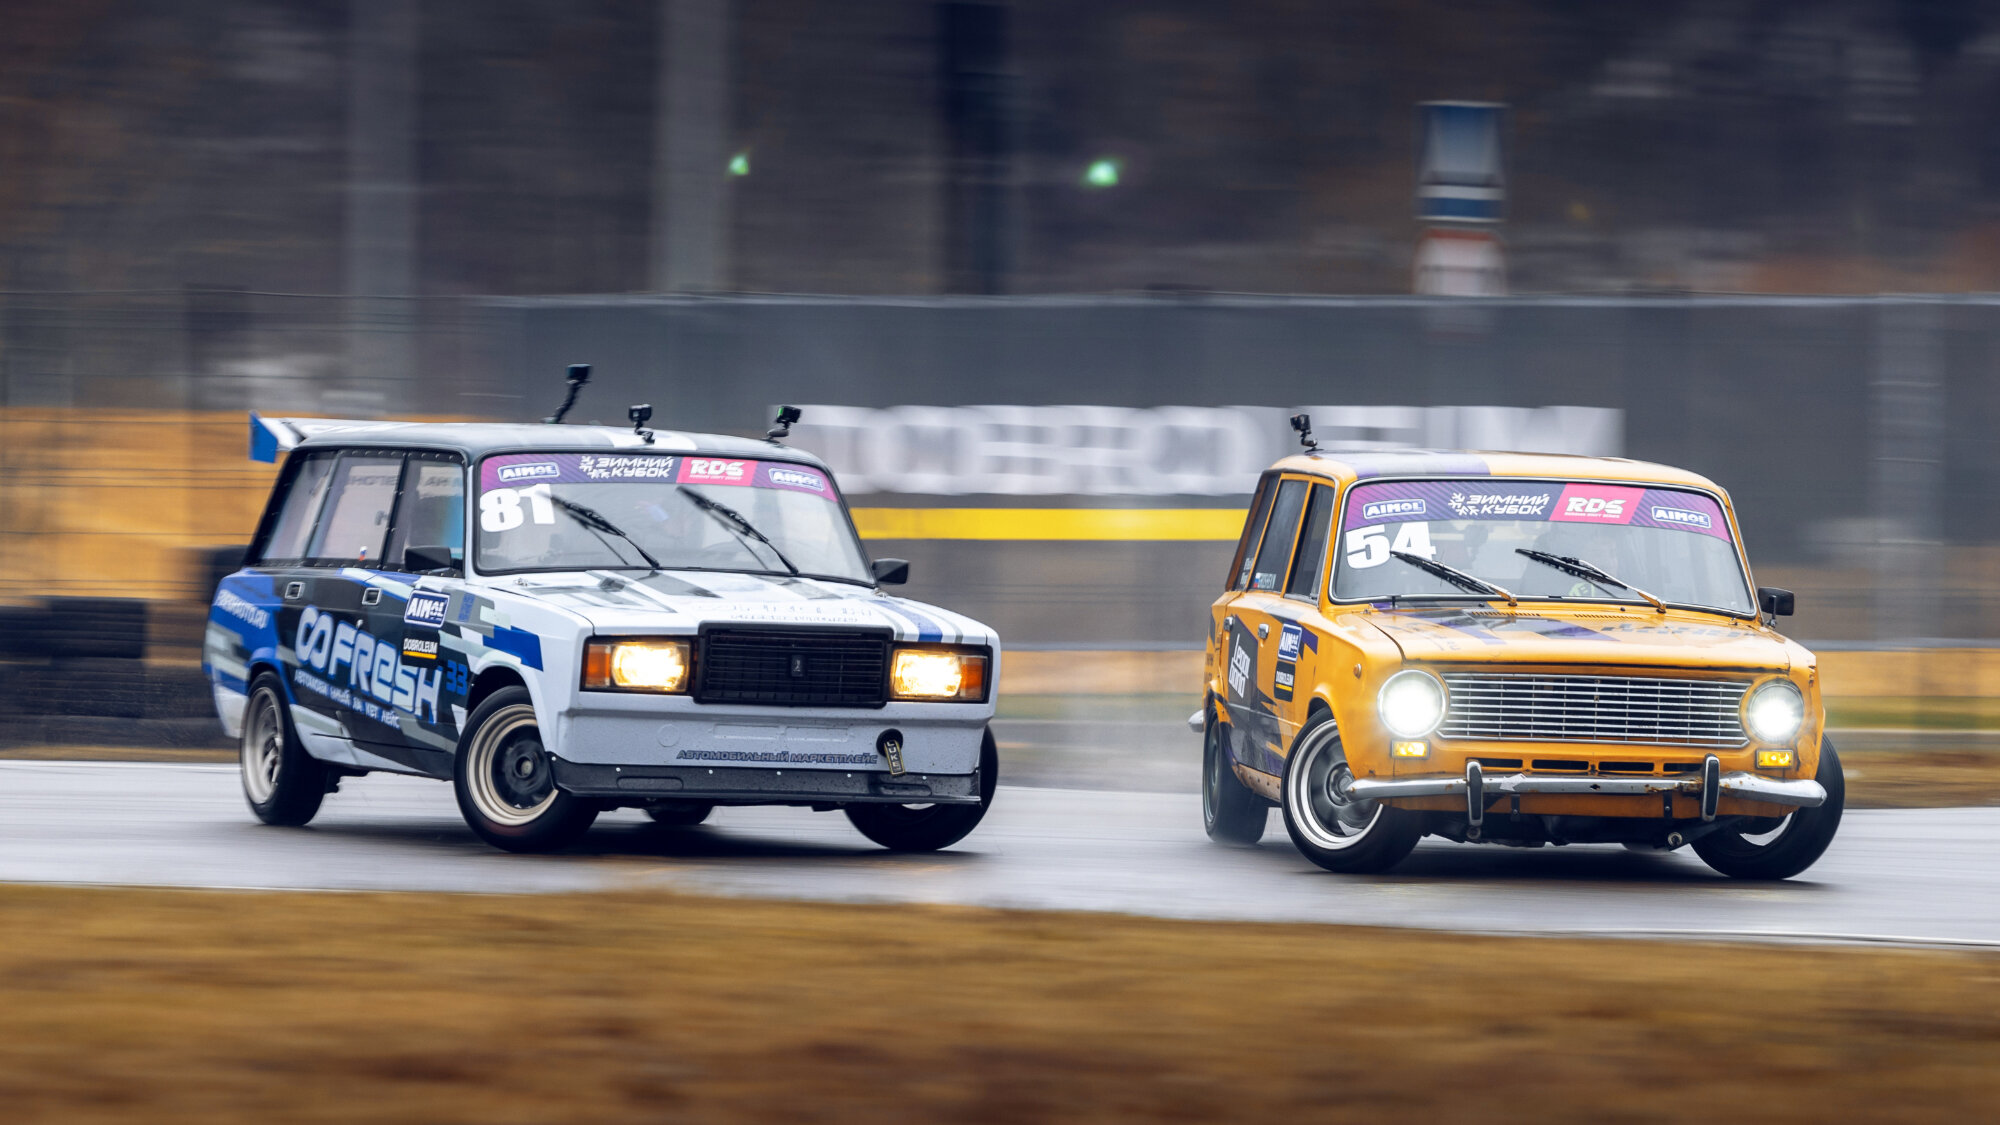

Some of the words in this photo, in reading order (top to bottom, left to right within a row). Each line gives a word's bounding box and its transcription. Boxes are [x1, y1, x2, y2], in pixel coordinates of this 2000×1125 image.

[596, 456, 674, 468] ЗИМНИЙ
[690, 459, 745, 476] RDS
[502, 465, 556, 479] AIMOL
[611, 467, 672, 478] КУБОК
[1466, 493, 1550, 505] ЗИМНИЙ
[1566, 497, 1626, 514] RDS
[480, 483, 555, 533] 81
[1366, 502, 1423, 516] AIMOL
[1480, 504, 1545, 515] КУБОК
[1655, 509, 1709, 525] AIMOL
[1345, 521, 1437, 569] 54
[407, 597, 445, 618] AIMOL
[403, 638, 437, 654] DOBROLEUM
[446, 660, 468, 695] 33
[676, 750, 789, 762] АВТОМОБИЛЬНЫЙ
[790, 752, 878, 764] МАРКЕТПЛЕЙС
